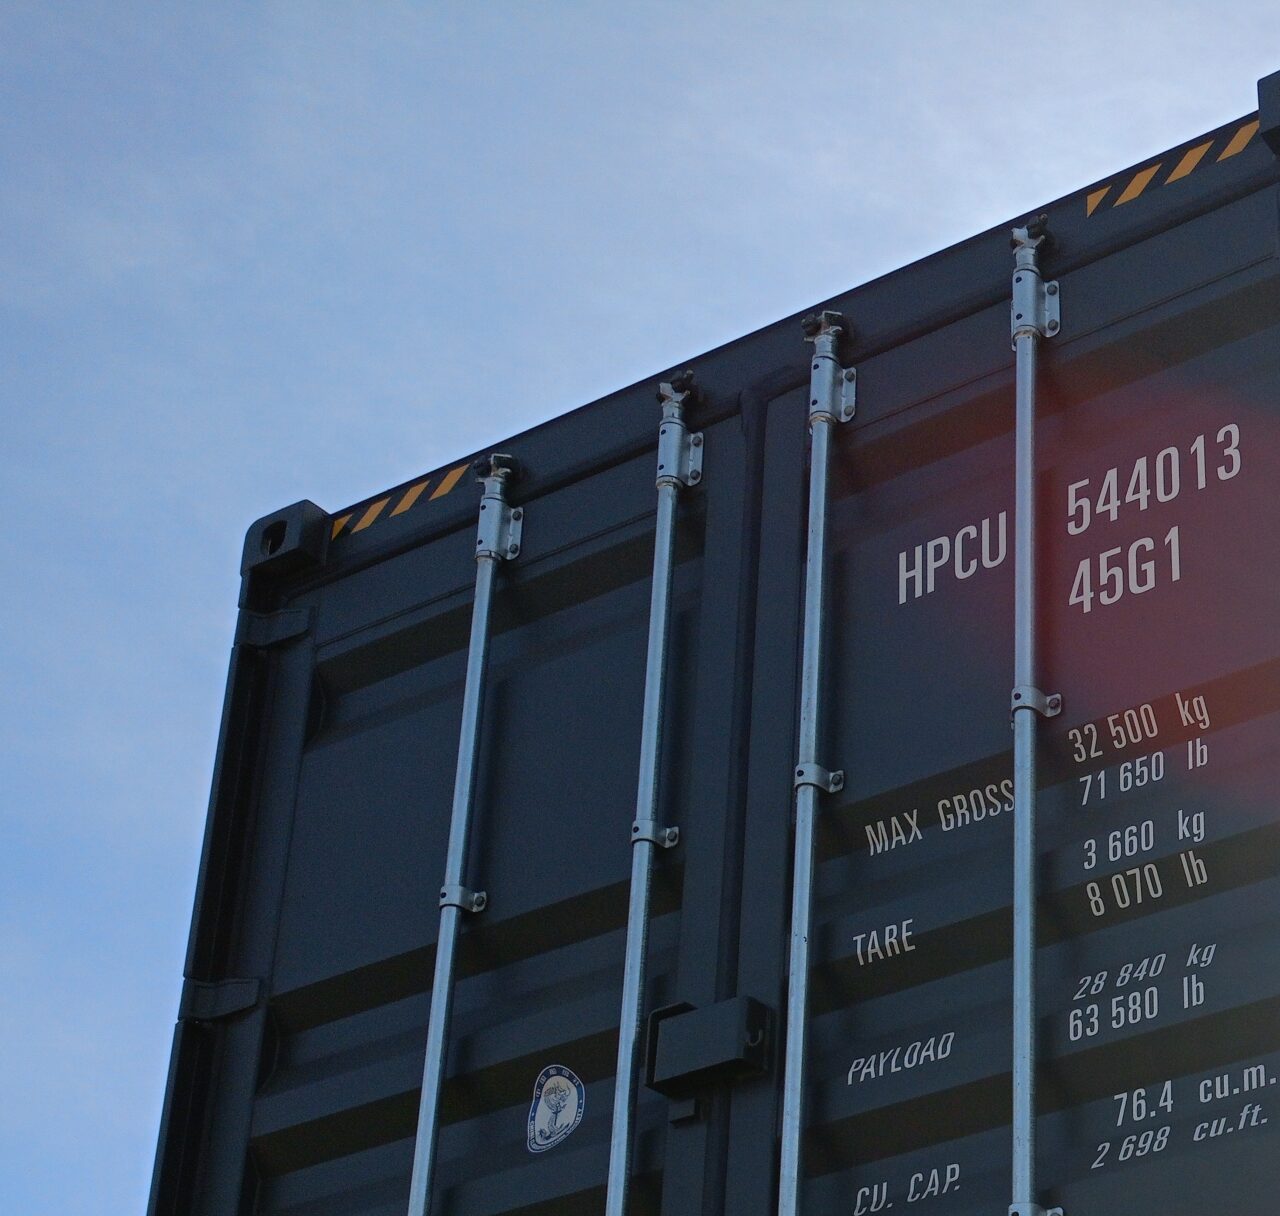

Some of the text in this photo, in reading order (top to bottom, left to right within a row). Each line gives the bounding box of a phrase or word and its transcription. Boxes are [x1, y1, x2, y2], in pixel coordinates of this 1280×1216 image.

[898, 423, 1242, 604] HPCU 544013
[1068, 526, 1182, 613] 45G1
[1068, 693, 1210, 762] 32 500 kg
[1079, 738, 1208, 805] 71 650 lb
[865, 779, 1014, 856] MAX GROSS
[1084, 809, 1205, 869] 3 660 kg
[1086, 851, 1208, 916] 8 070 lb
[853, 919, 916, 966] TARE
[1073, 942, 1216, 1000] 28 840 kg
[1069, 974, 1204, 1041] 63 580 lb
[847, 1032, 955, 1085] PAYLOAD
[1113, 1062, 1277, 1127] 76.4 cu.m.
[1091, 1103, 1268, 1170] 2 698 cu.ft.
[853, 1163, 961, 1216] CU. CAP.
